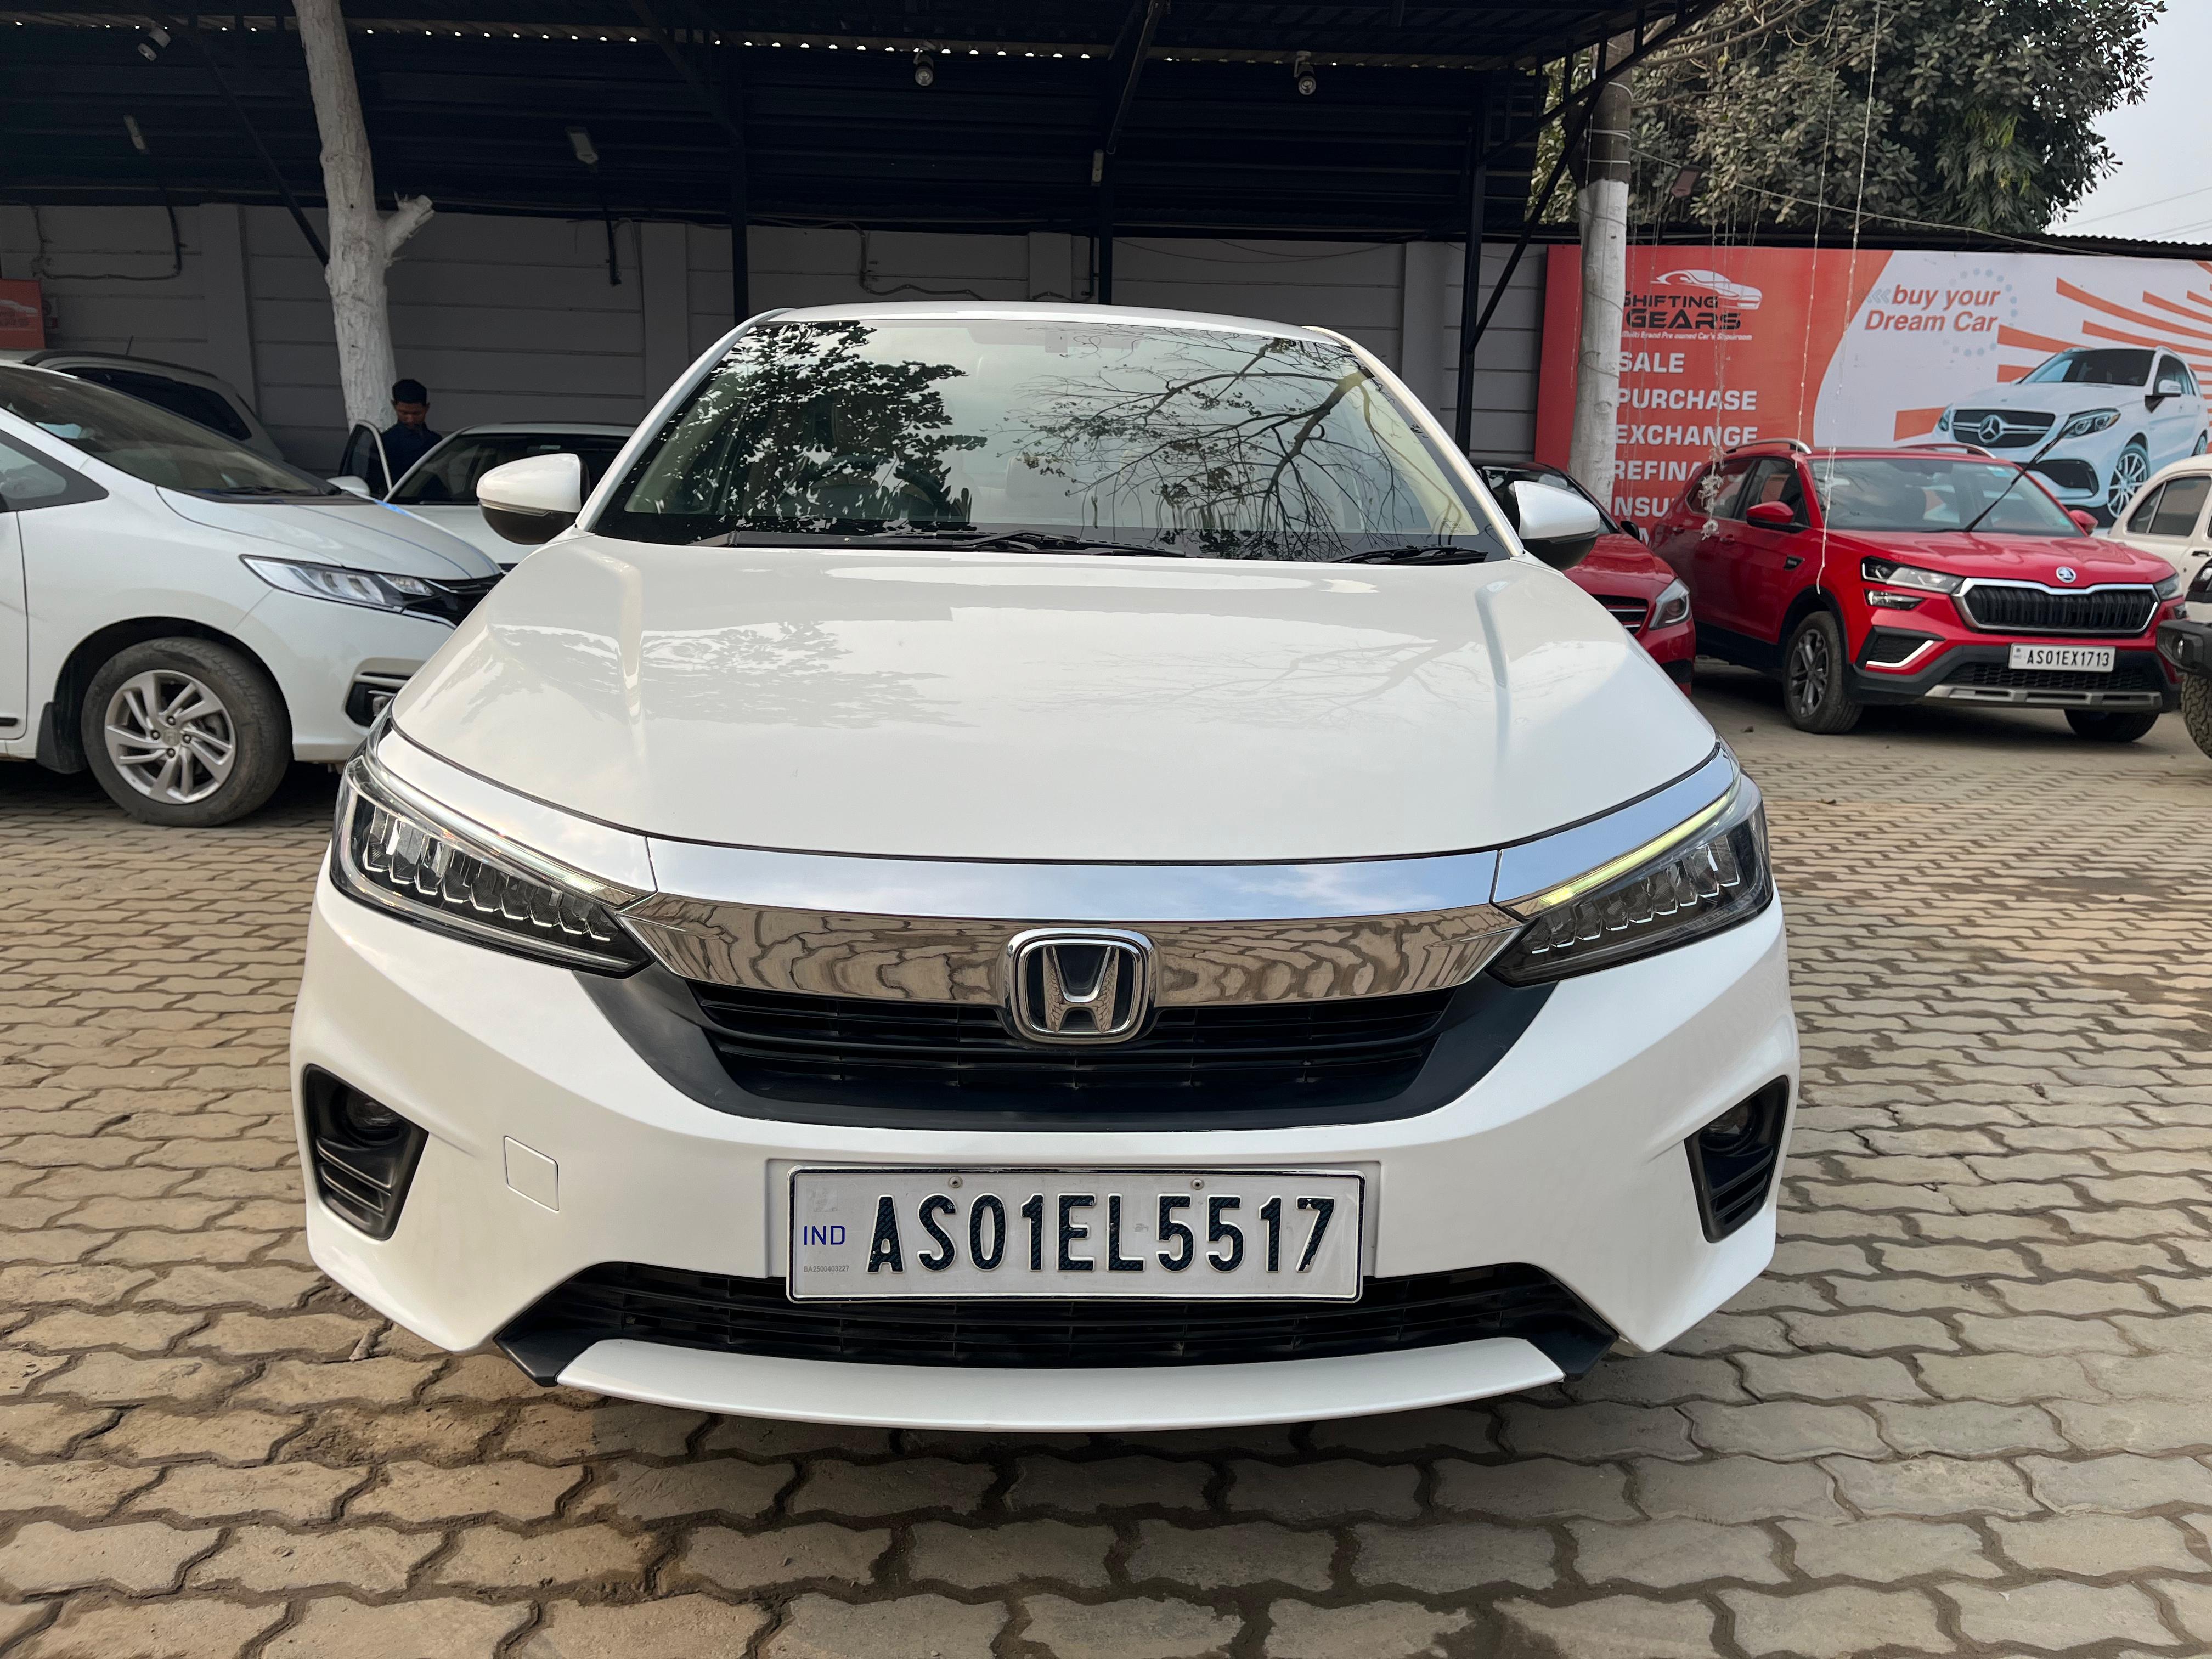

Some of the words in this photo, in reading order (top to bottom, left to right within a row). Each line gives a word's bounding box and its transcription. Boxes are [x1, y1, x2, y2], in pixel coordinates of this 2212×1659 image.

[1624, 290, 1718, 308] SHIFTING
[1892, 284, 1939, 311] buy
[1943, 289, 2001, 311] your
[1626, 308, 1741, 330] GEARS
[1865, 309, 1946, 331] Dream
[1954, 311, 1999, 332] Car
[1619, 351, 1685, 374] SALE
[1617, 387, 1758, 411] PURCHASE
[1615, 424, 1758, 447] EXCHANGE
[1614, 496, 1675, 517] NSU
[2027, 649, 2110, 667] AS01EX1713
[804, 1226, 845, 1245] IND
[866, 1193, 1336, 1273] AS01EL5517
